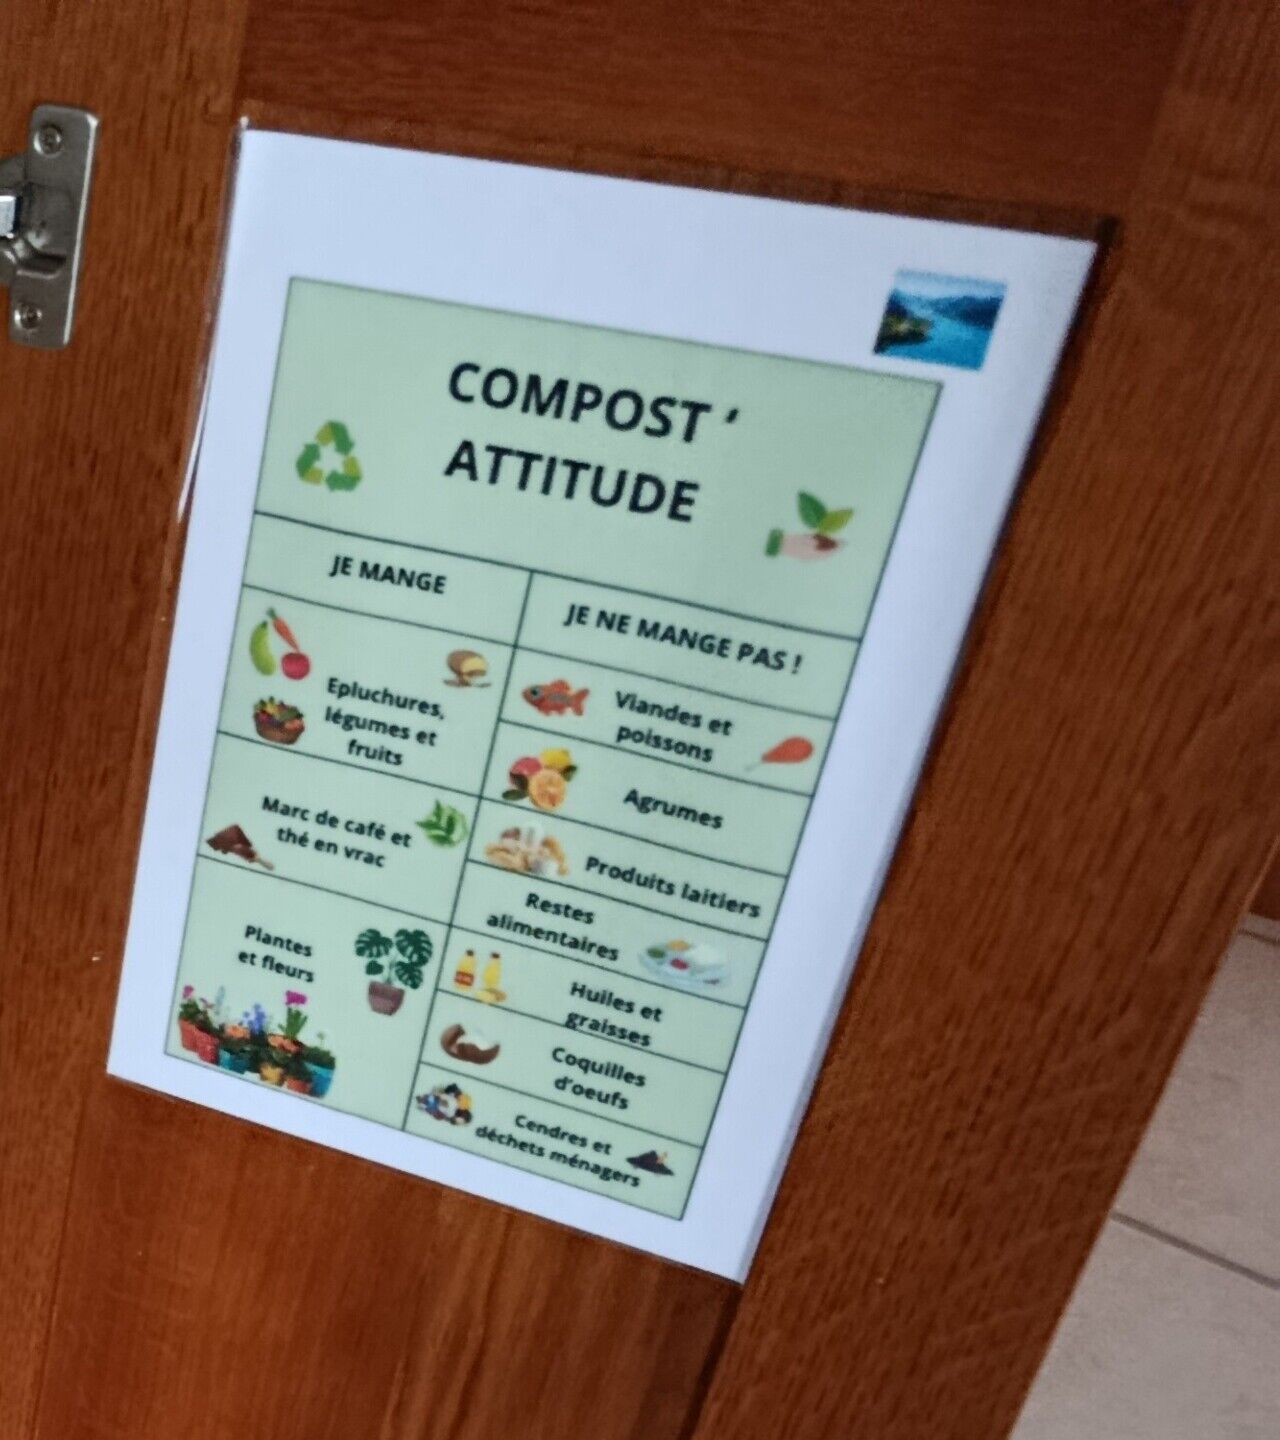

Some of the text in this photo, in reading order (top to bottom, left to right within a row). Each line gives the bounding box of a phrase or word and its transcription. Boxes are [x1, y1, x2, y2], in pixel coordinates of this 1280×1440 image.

[444, 439, 701, 523] ATTITUDE
[329, 555, 447, 595] JE MANGE
[564, 603, 591, 627] JE
[596, 608, 630, 635] NE
[636, 617, 731, 659] MANGE
[737, 642, 786, 673] PAS
[327, 677, 444, 720] Epluchures,
[615, 690, 733, 736] Viandes et
[325, 706, 437, 746] légumes et
[616, 726, 713, 763] poissons
[347, 739, 403, 766] fruits
[262, 796, 412, 848] Marc de café et
[623, 789, 723, 829] Agrumes
[277, 827, 386, 868] thé en vrac
[585, 856, 761, 919] Produits laitiers
[525, 893, 595, 924] Restes
[245, 925, 312, 957] Plantes
[487, 914, 619, 961] alimentaires
[238, 951, 314, 983] et fleurs
[570, 982, 662, 1023] Huiles et
[565, 1012, 651, 1047] graisses
[552, 1047, 646, 1087] Coquilles
[554, 1076, 629, 1110] d'oeufs
[515, 1114, 612, 1155] Cendres et
[476, 1125, 641, 1187] déchets ménagers
